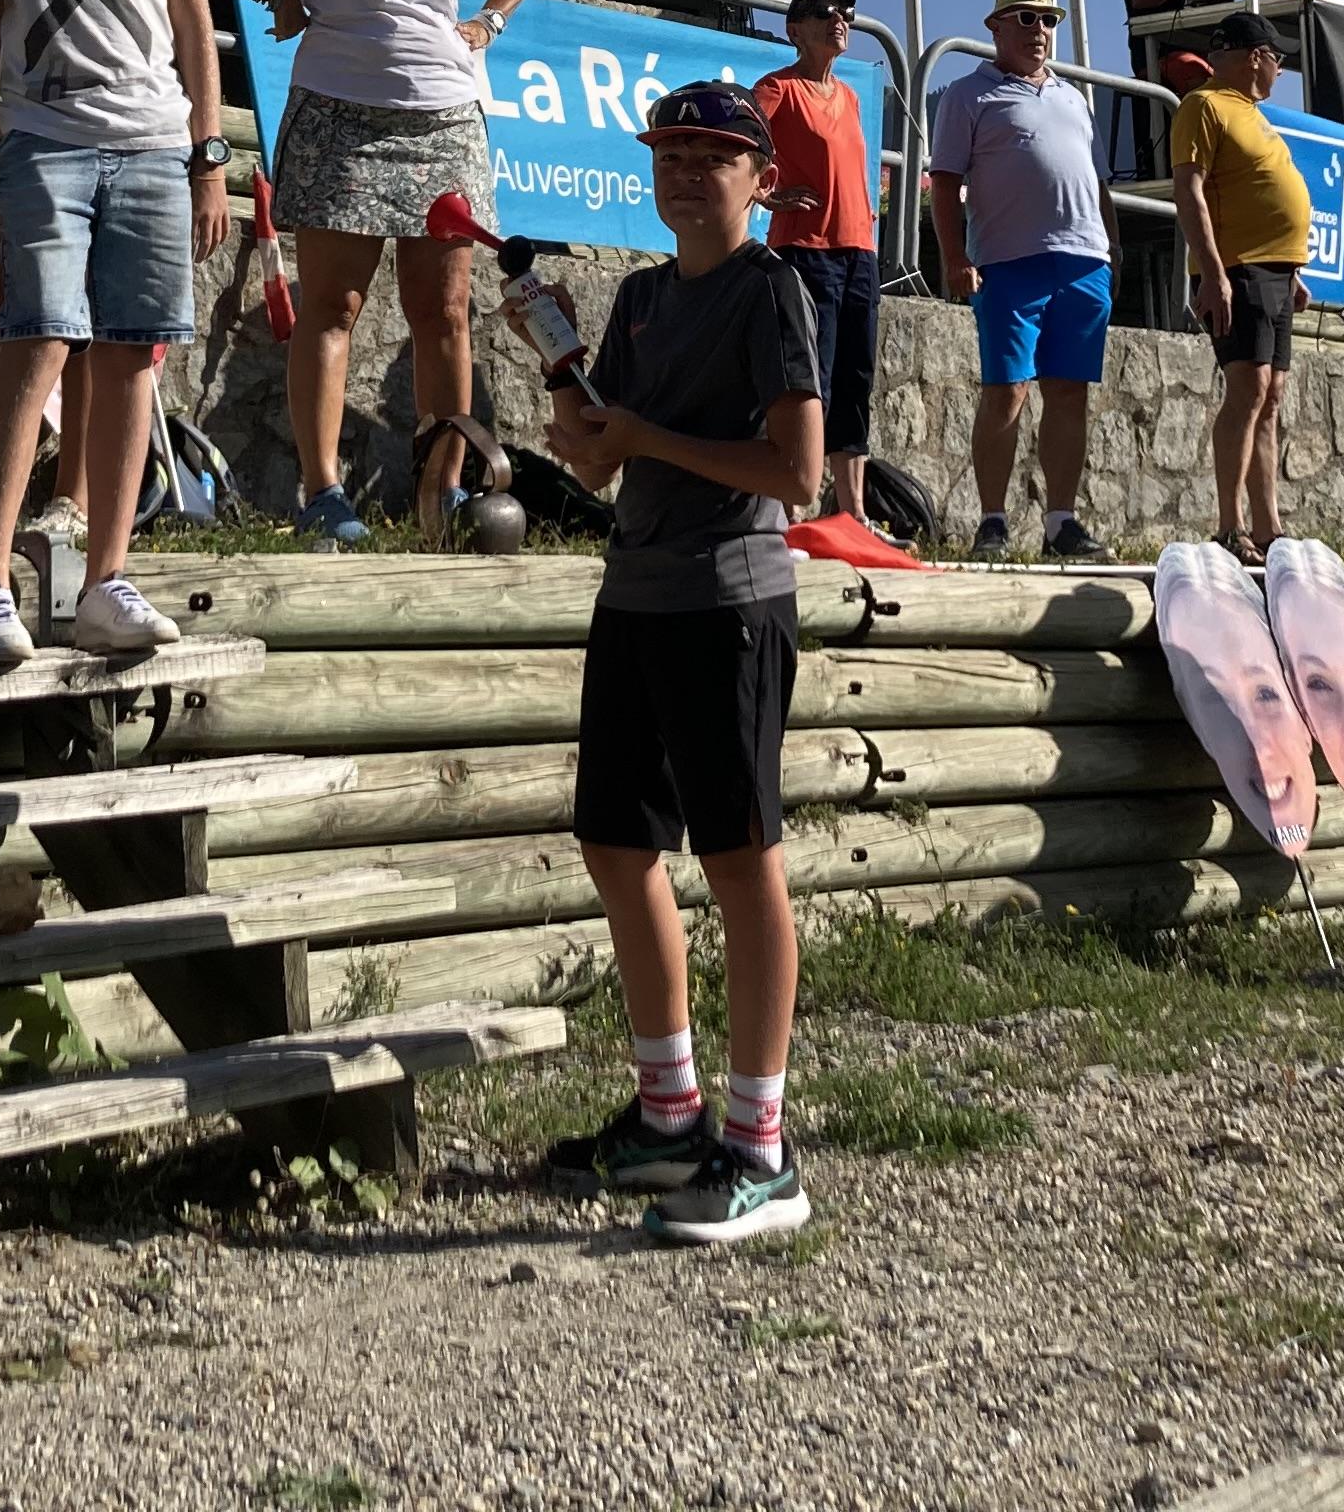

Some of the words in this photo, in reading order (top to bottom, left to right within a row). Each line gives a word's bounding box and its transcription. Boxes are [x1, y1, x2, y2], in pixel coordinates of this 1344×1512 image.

[476, 47, 566, 124] La
[492, 148, 653, 210] Auvergne-
[1307, 224, 1338, 265] eu
